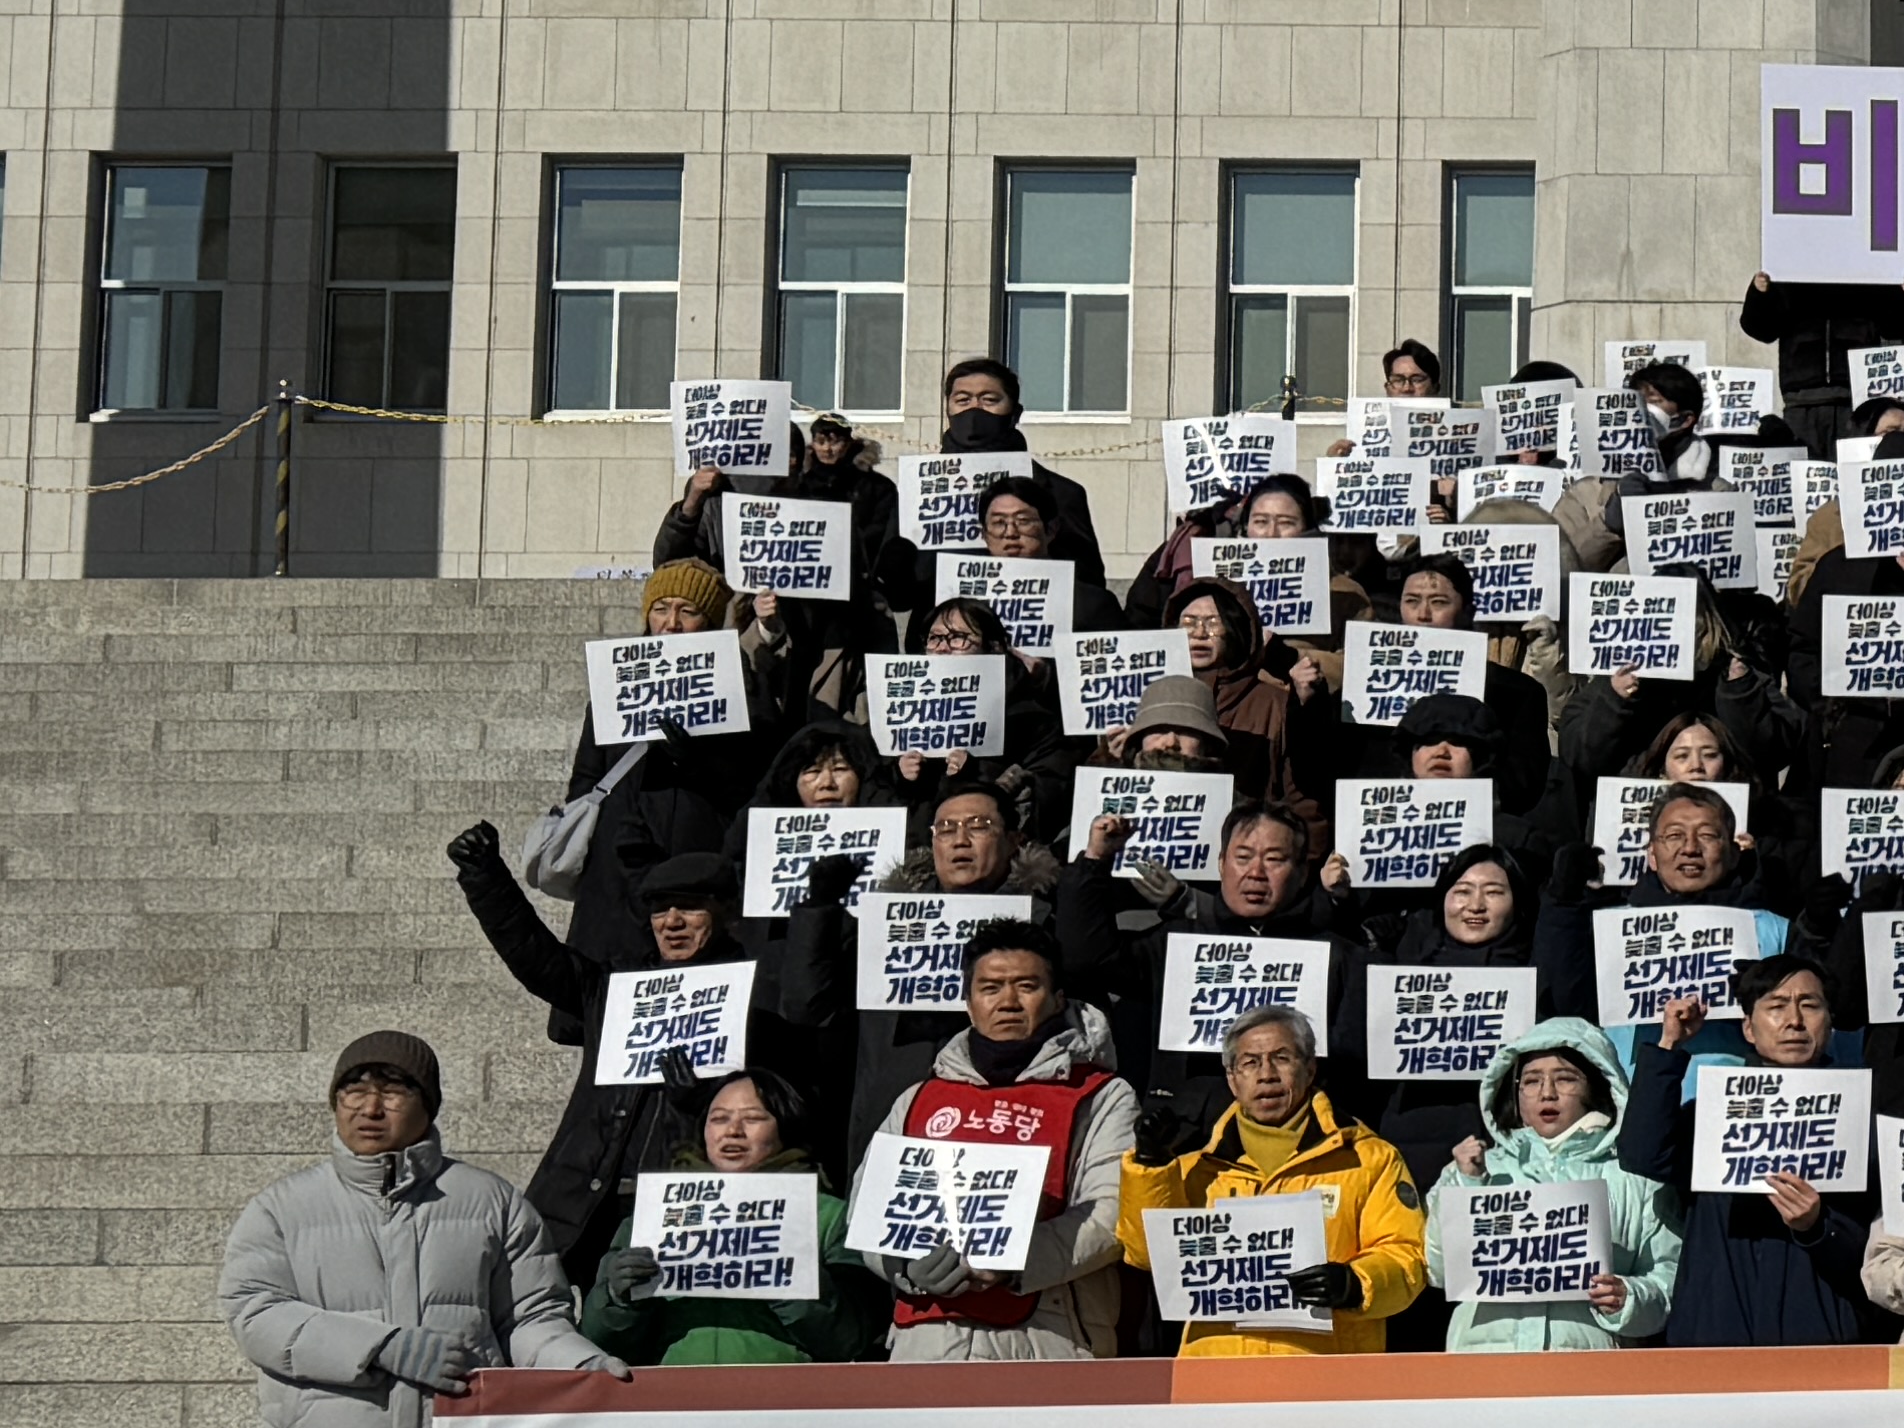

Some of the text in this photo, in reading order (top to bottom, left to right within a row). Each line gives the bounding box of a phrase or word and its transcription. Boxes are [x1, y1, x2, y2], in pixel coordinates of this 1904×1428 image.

[685, 384, 721, 403] 더이상
[711, 402, 724, 417] 수
[685, 418, 763, 447] 선거제도
[1864, 483, 1893, 502] 늦출
[739, 502, 780, 519] 더이상
[770, 521, 785, 537] 수
[739, 540, 823, 563] 선거제도
[742, 565, 829, 589] 개혁하라!
[1846, 601, 1896, 620] 더이상
[1848, 621, 1881, 639] 늦출
[1885, 620, 1901, 637] 수
[884, 660, 930, 679] 더이상
[887, 674, 980, 698] 늦출 수 없다!
[886, 695, 977, 725] 선거제도
[891, 722, 985, 752] 개혁하라!
[1725, 1074, 1783, 1096] 더이상
[1726, 1093, 1841, 1120] 늦출 수 없다!
[963, 1109, 1042, 1141] 노동당
[1722, 1118, 1836, 1153] 선거제도
[663, 1179, 725, 1203] 더이상
[1470, 1190, 1532, 1215] 더이상
[662, 1199, 786, 1228] 늦출 수 없다!
[1473, 1203, 1589, 1237] 늦출 수 없다!
[657, 1224, 781, 1261] 선거제도
[1472, 1229, 1587, 1267] 선거제도
[658, 1257, 790, 1291] 개혁하라!
